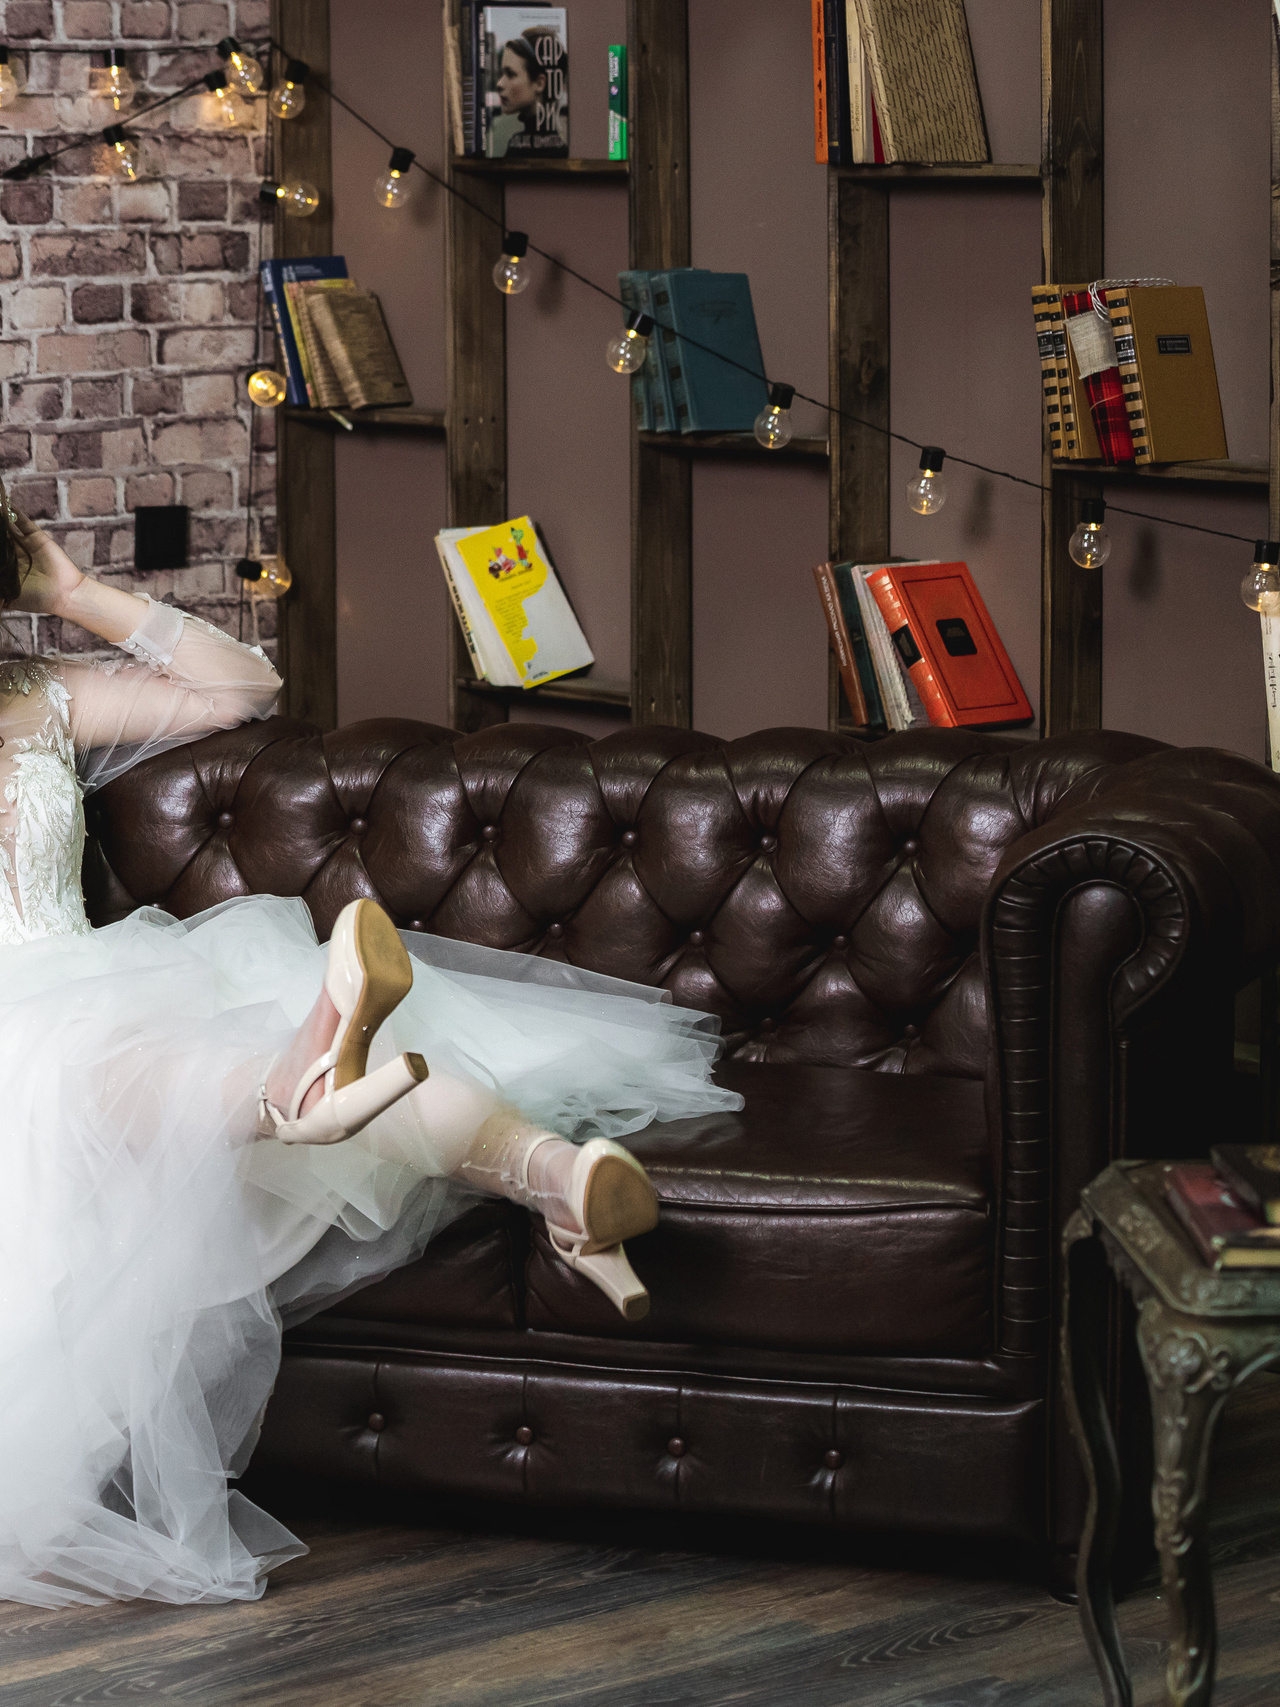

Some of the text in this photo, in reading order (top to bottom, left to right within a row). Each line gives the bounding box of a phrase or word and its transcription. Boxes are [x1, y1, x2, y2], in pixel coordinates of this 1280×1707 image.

[535, 36, 563, 66] САР
[545, 68, 564, 99] ТО
[536, 102, 563, 131] РИС
